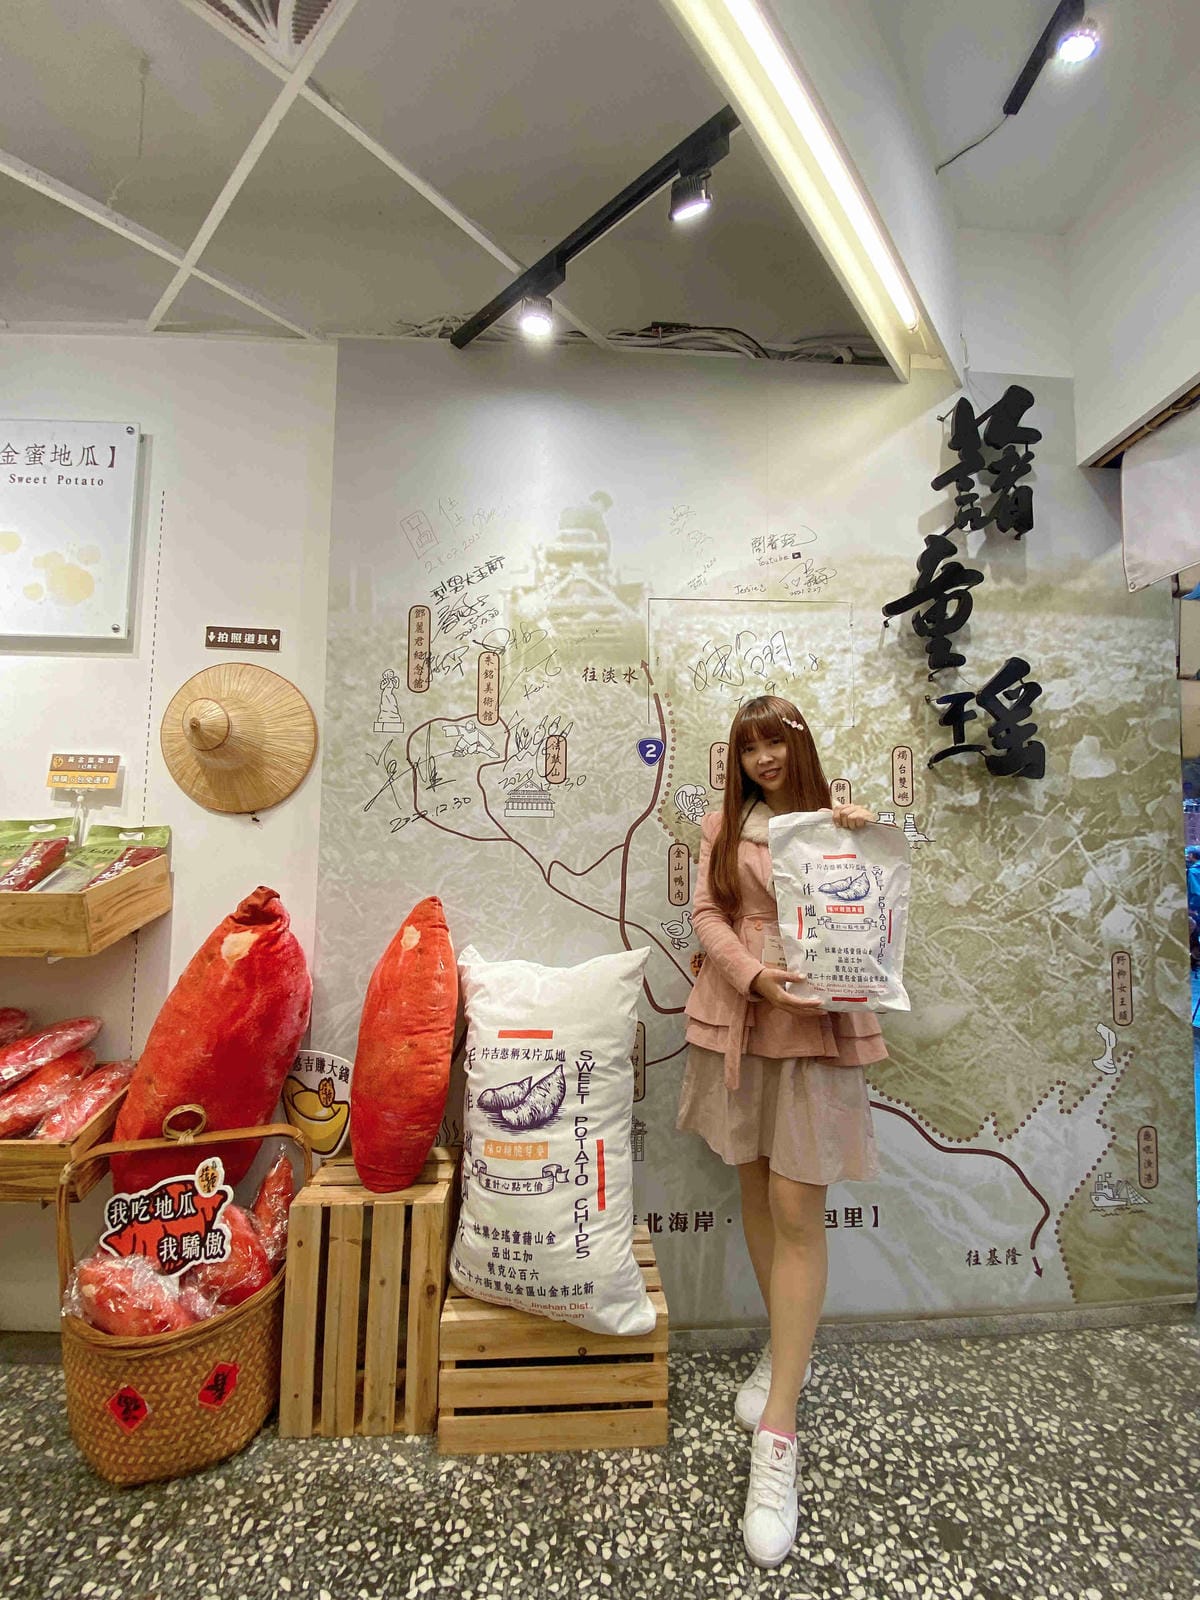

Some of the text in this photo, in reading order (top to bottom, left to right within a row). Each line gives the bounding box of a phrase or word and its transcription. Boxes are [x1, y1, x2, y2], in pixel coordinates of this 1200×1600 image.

[9, 473, 104, 487] Sweet Potato
[217, 631, 269, 646] 拍照道具
[482, 654, 495, 721] 朱銘美術館
[582, 666, 639, 684] 往淡水
[645, 744, 657, 757] 2
[897, 750, 909, 802] 燭台雙嶼
[673, 847, 685, 901] 金山鴨肉
[801, 862, 818, 962] 手作地瓜片
[878, 896, 887, 931] POTATO
[877, 936, 887, 965] CHIPS
[574, 1050, 596, 1259] SWEET POTATO CHIPS
[110, 1192, 197, 1224] 我吃地瓜
[159, 1231, 224, 1262] 我驕傲
[965, 1248, 1022, 1267] 往基隆
